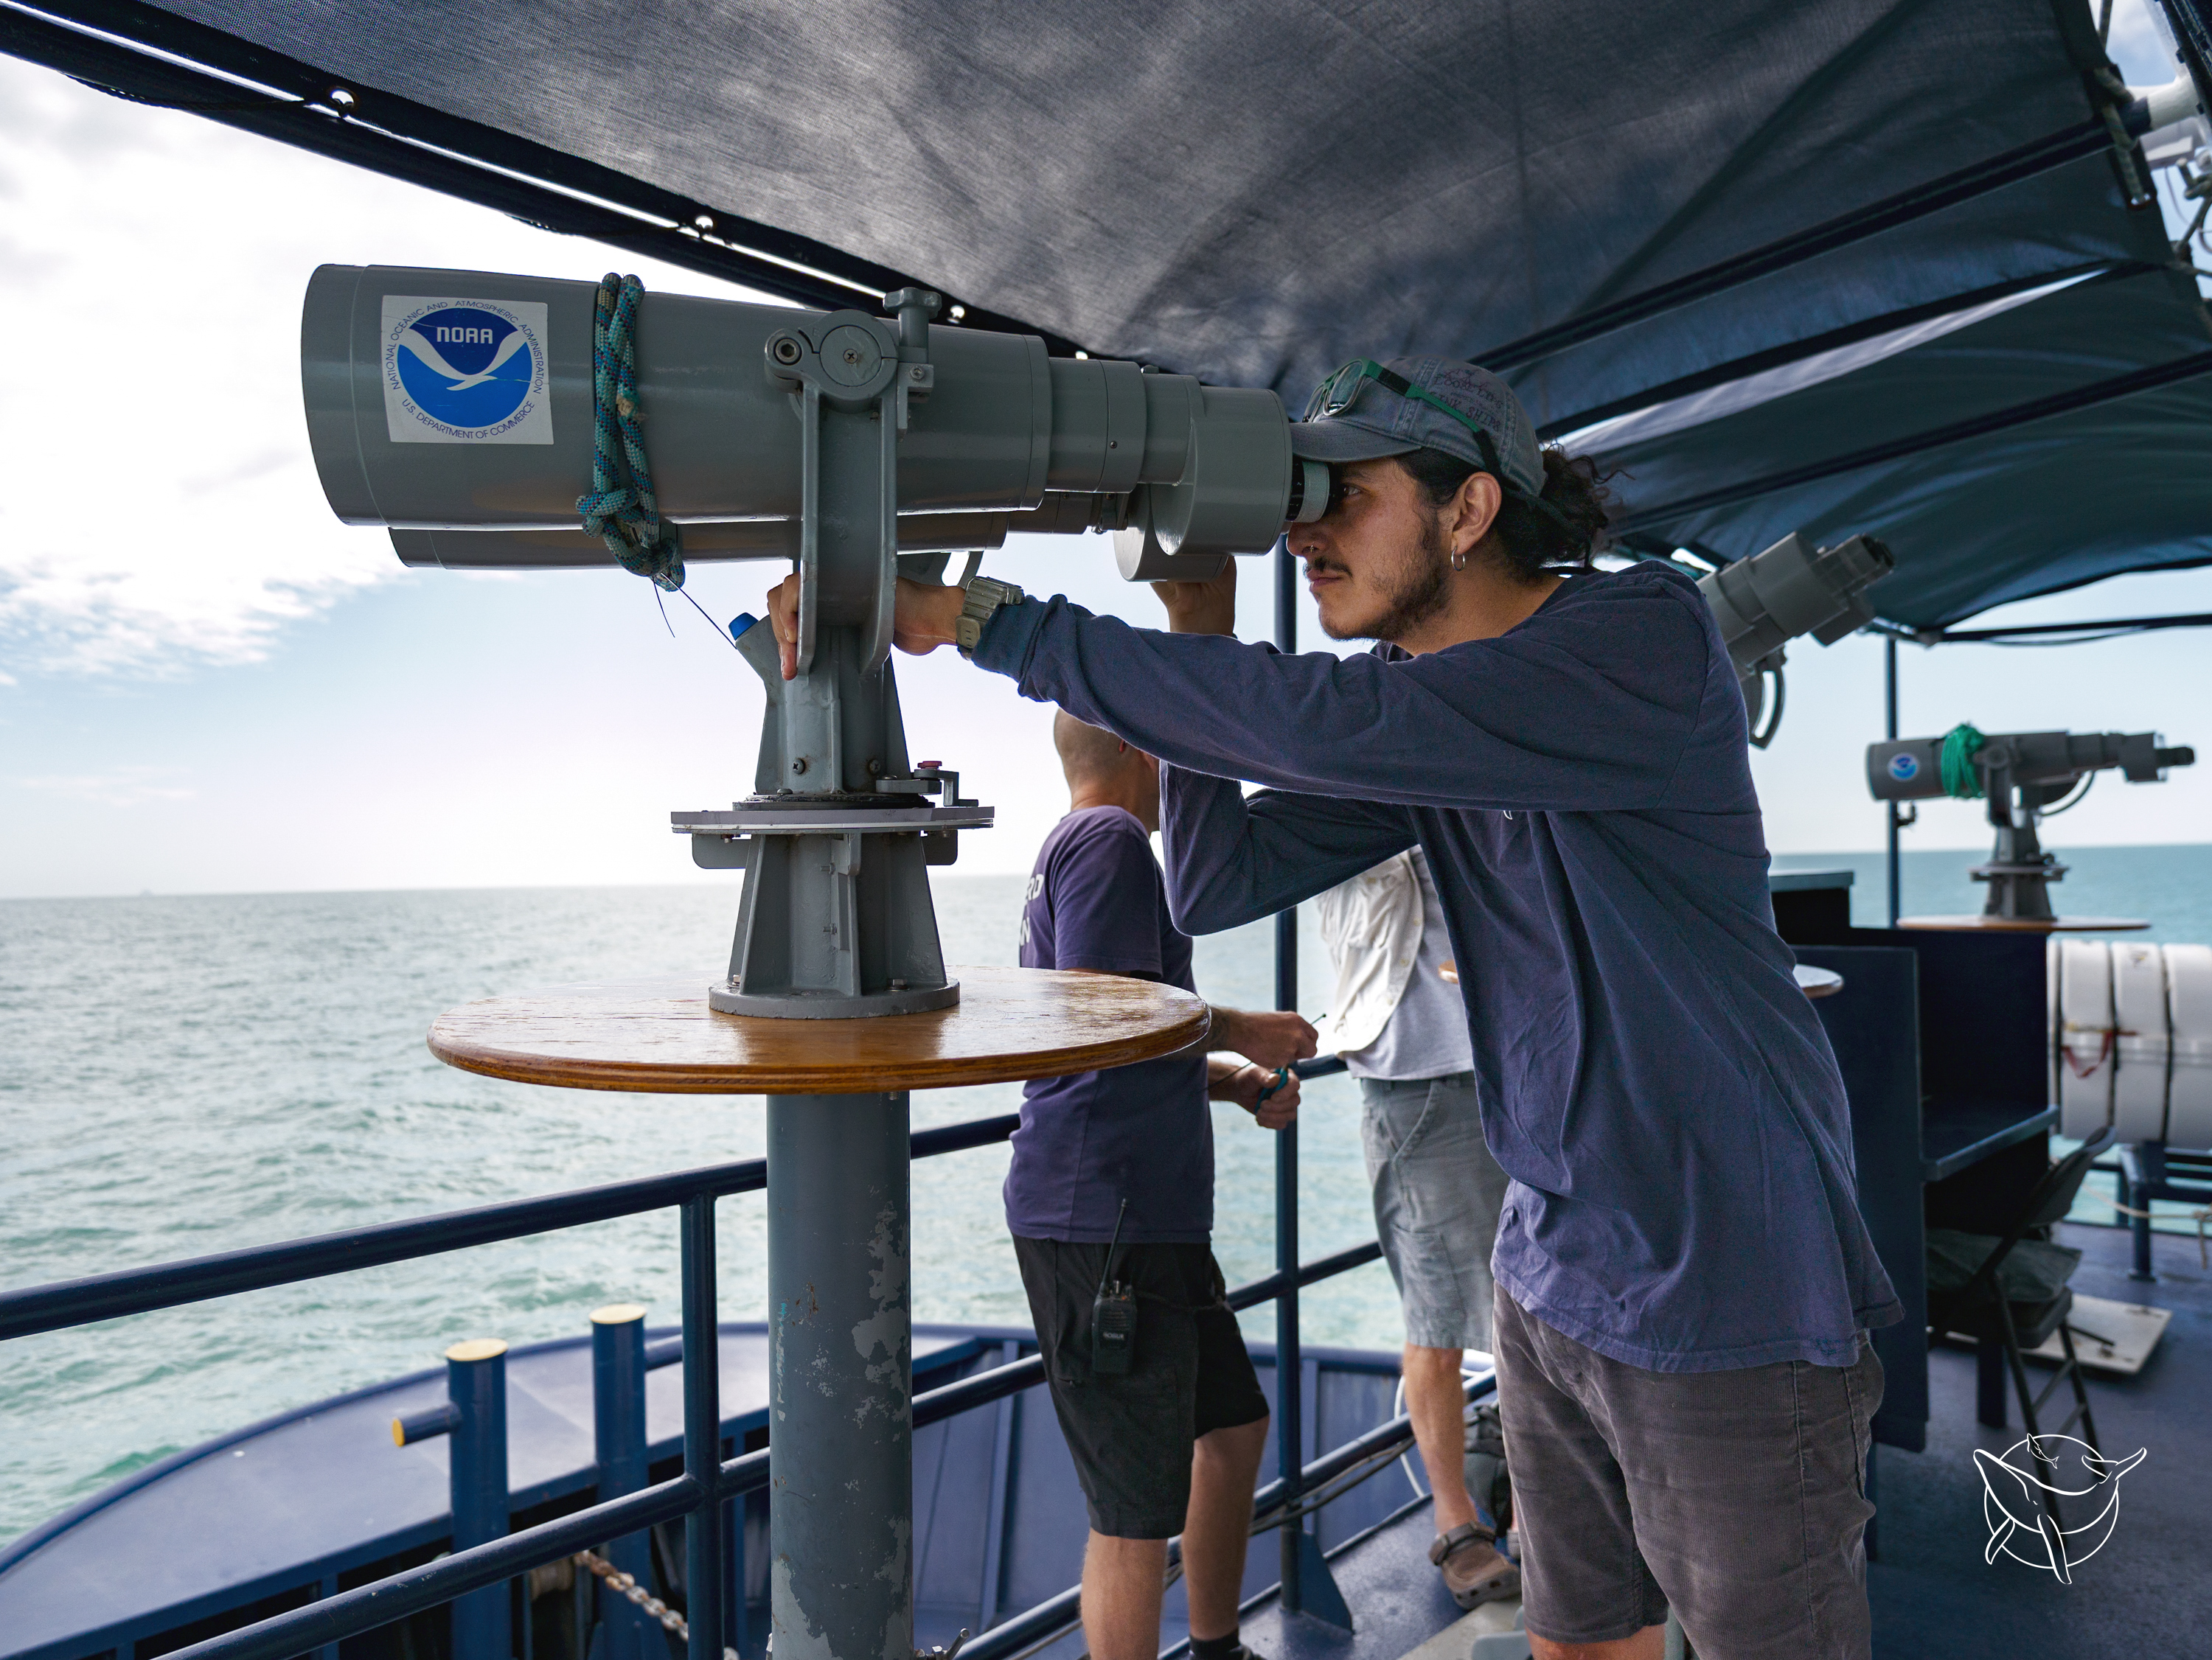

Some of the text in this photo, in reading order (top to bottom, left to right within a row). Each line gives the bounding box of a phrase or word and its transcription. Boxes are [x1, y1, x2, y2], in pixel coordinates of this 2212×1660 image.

[386, 300, 544, 394] NATIONAL OCEANIC AND ATMOSPHERIC ADMINISTRATION
[437, 327, 493, 344] NOAA
[402, 399, 535, 439] U.S. DEPARTMENT OF COMMERCE
